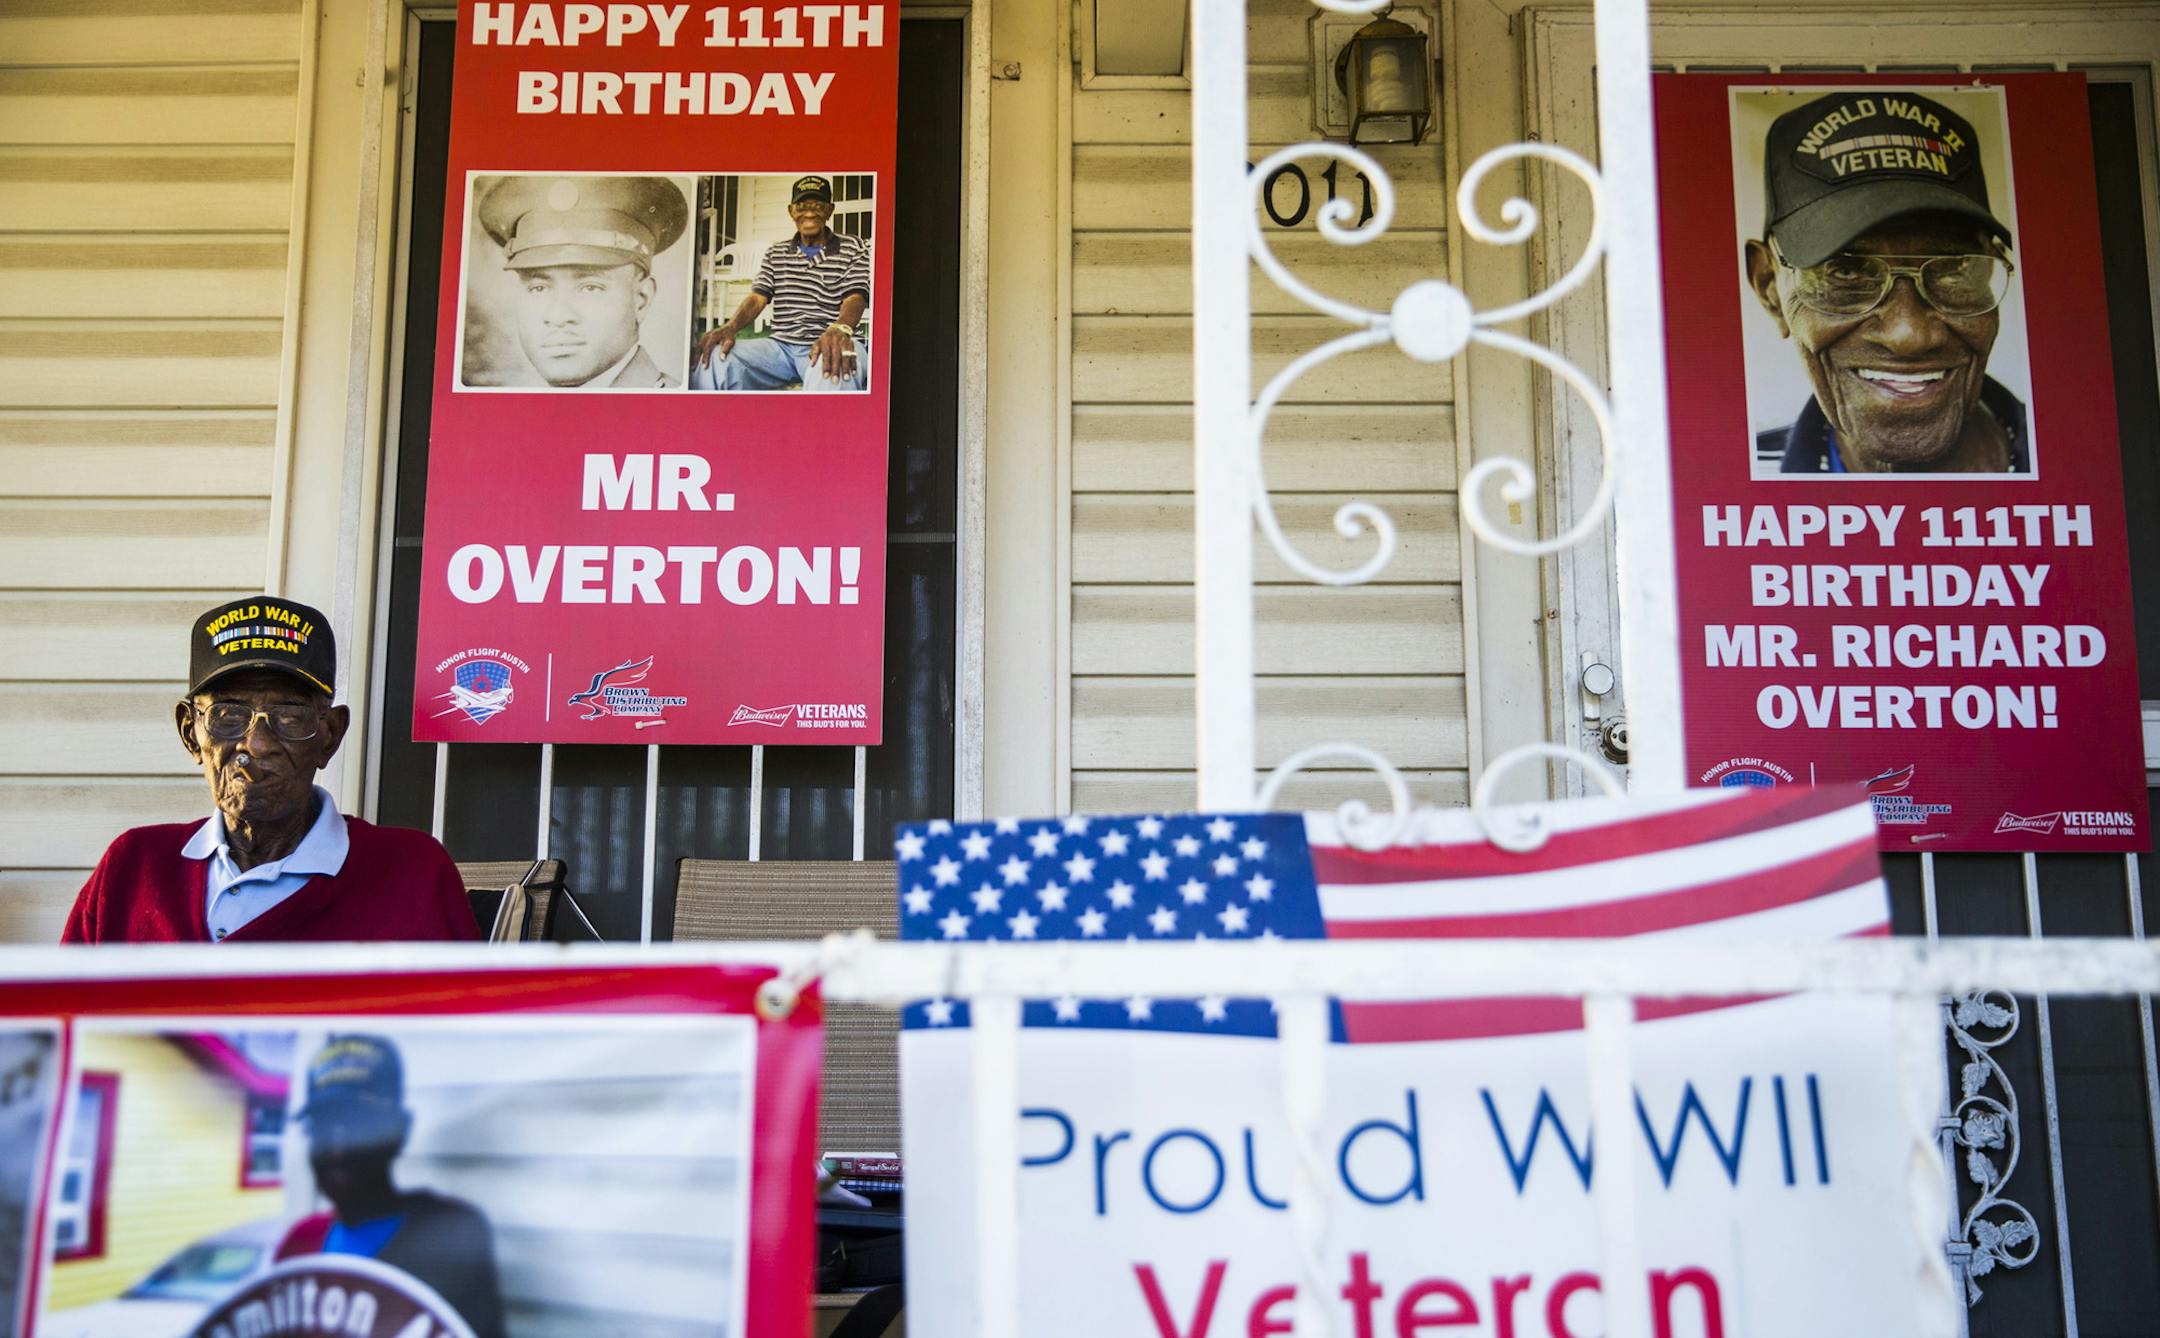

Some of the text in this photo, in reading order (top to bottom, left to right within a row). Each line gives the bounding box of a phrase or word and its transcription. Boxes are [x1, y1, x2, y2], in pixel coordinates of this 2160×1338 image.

[472, 3, 884, 48] HAPPY 111TH
[517, 71, 836, 115] BIRTHDAY
[1797, 98, 1965, 154] WORLD WAR II
[1831, 148, 1948, 176] VETERAN
[1246, 159, 1374, 228] 011
[581, 453, 735, 511] MR.
[1702, 505, 2094, 547] HAPPY 111TH
[447, 544, 861, 606] OVERTON!
[1750, 564, 2051, 607] BIRTHDAY
[206, 605, 314, 637] WORLD WAR II
[219, 638, 299, 656] VETERAN
[435, 648, 531, 674] HONOR FLIGHT AUSTIN
[1704, 624, 2107, 668] MR. RICHARD
[733, 708, 789, 721] Budweiser
[796, 720, 812, 728] THIS
[814, 720, 835, 728] BUD'S
[836, 720, 850, 728] FOR
[1756, 685, 2059, 730] OVERTON!
[1701, 757, 1794, 783] HONOR FLIGHT AUSTIN
[2001, 815, 2056, 828] Budweiser
[2064, 827, 2080, 836] THIS
[2081, 827, 2102, 836] BUD'S
[2104, 827, 2118, 836] FOR
[1019, 1073, 1830, 1217] Proud WWII
